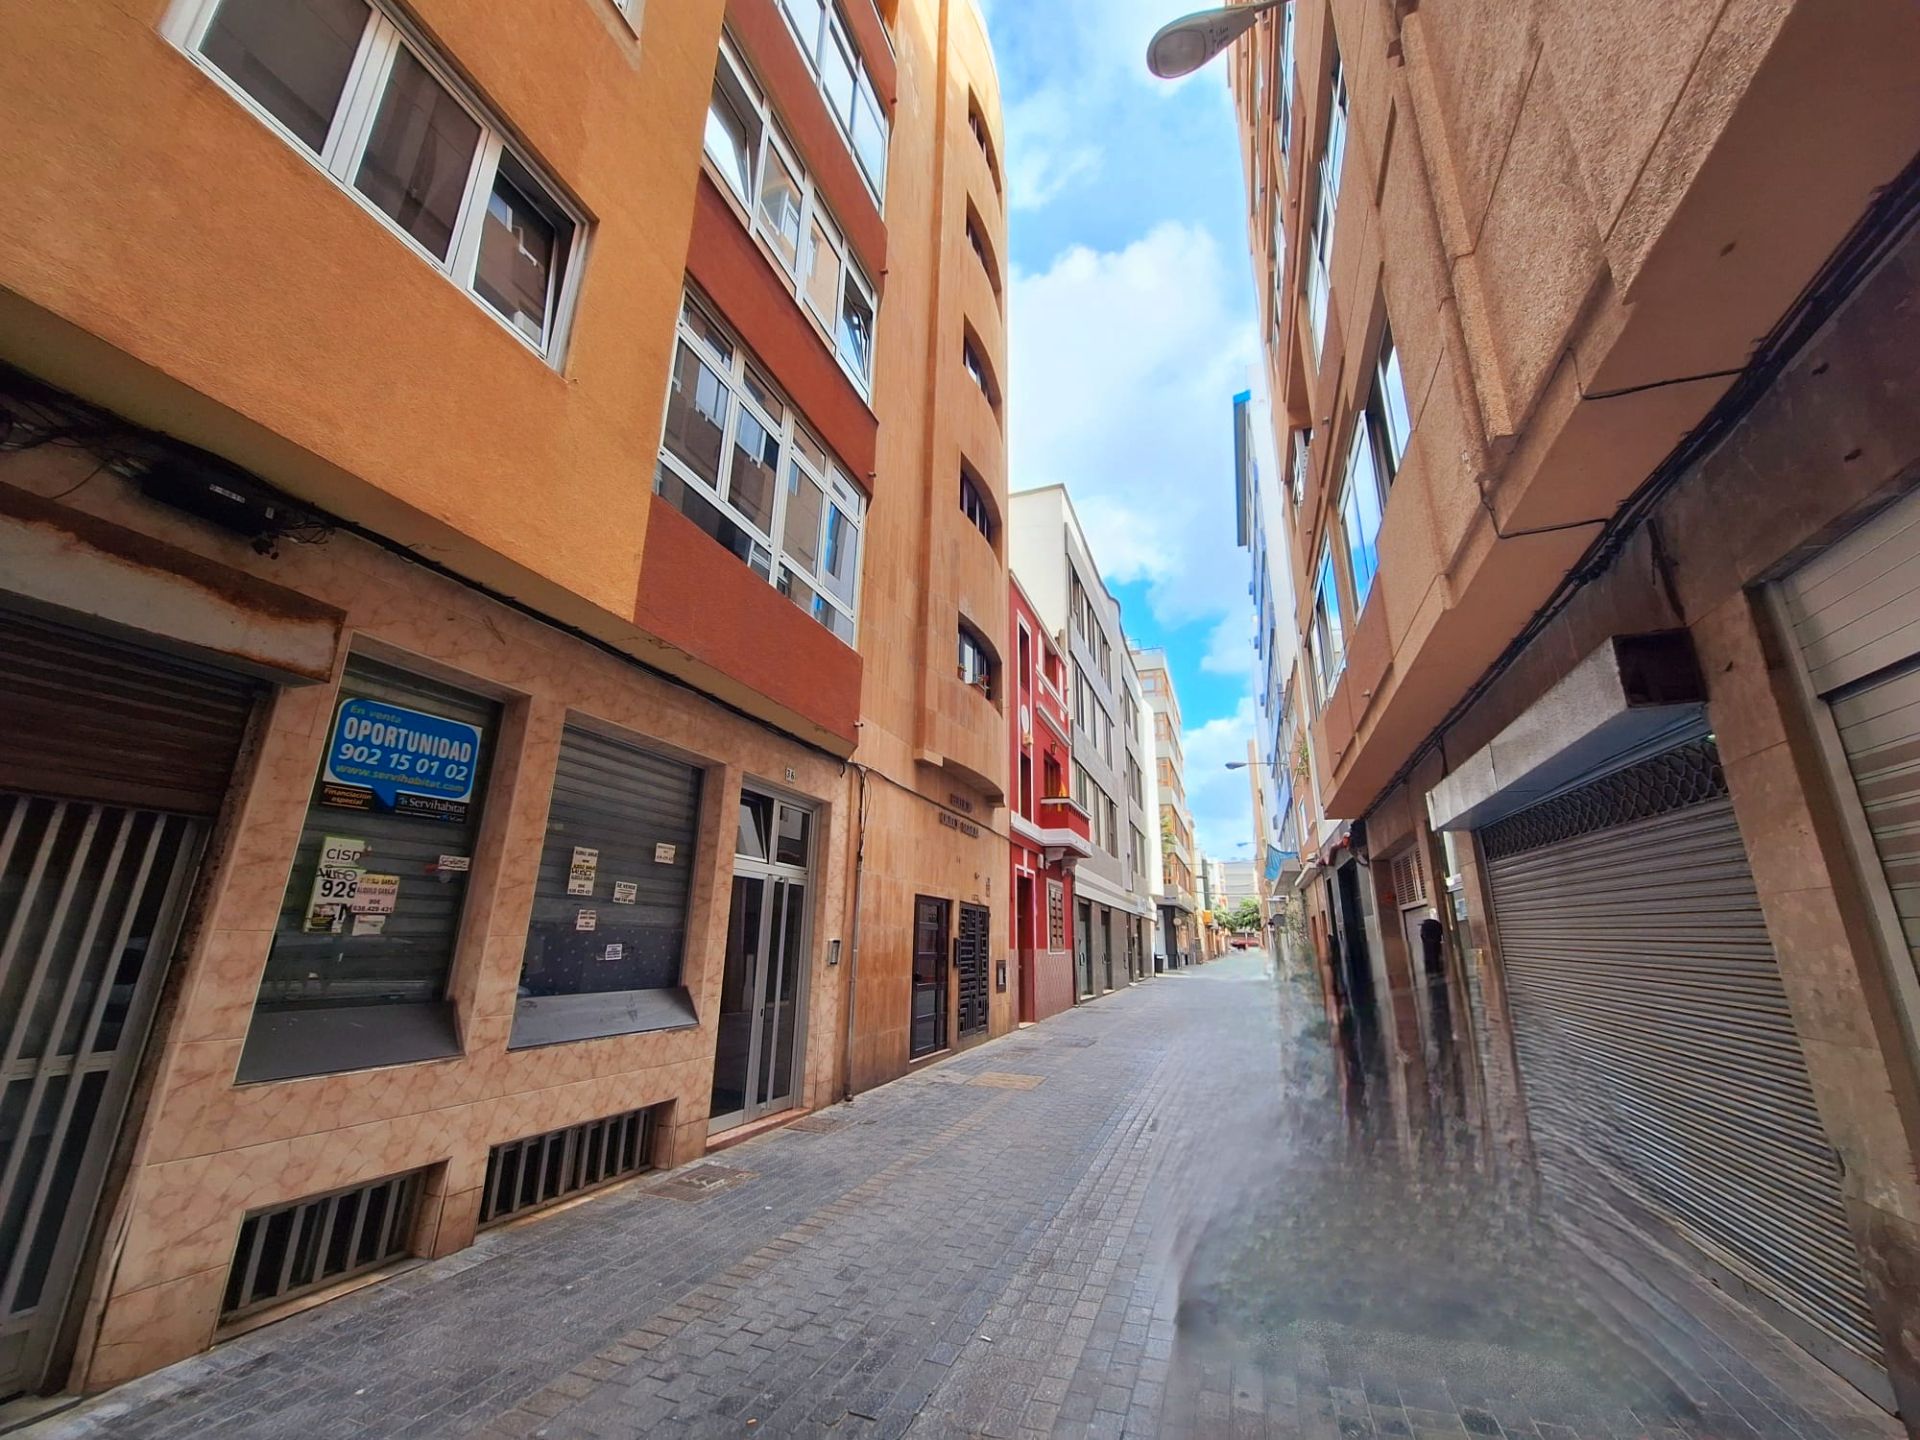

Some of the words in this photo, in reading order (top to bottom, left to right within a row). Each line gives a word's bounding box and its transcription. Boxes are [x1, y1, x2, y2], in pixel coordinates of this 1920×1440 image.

[350, 704, 366, 716] En
[368, 710, 401, 723] venta
[343, 716, 472, 763] OPORTUNIDAD
[338, 743, 382, 765] 902
[389, 753, 413, 770] 15
[415, 758, 440, 776] 01
[444, 763, 469, 781] 02
[335, 764, 465, 792] www.servihabitat.com
[409, 797, 466, 813] Servihabitat
[320, 880, 358, 899] 928
